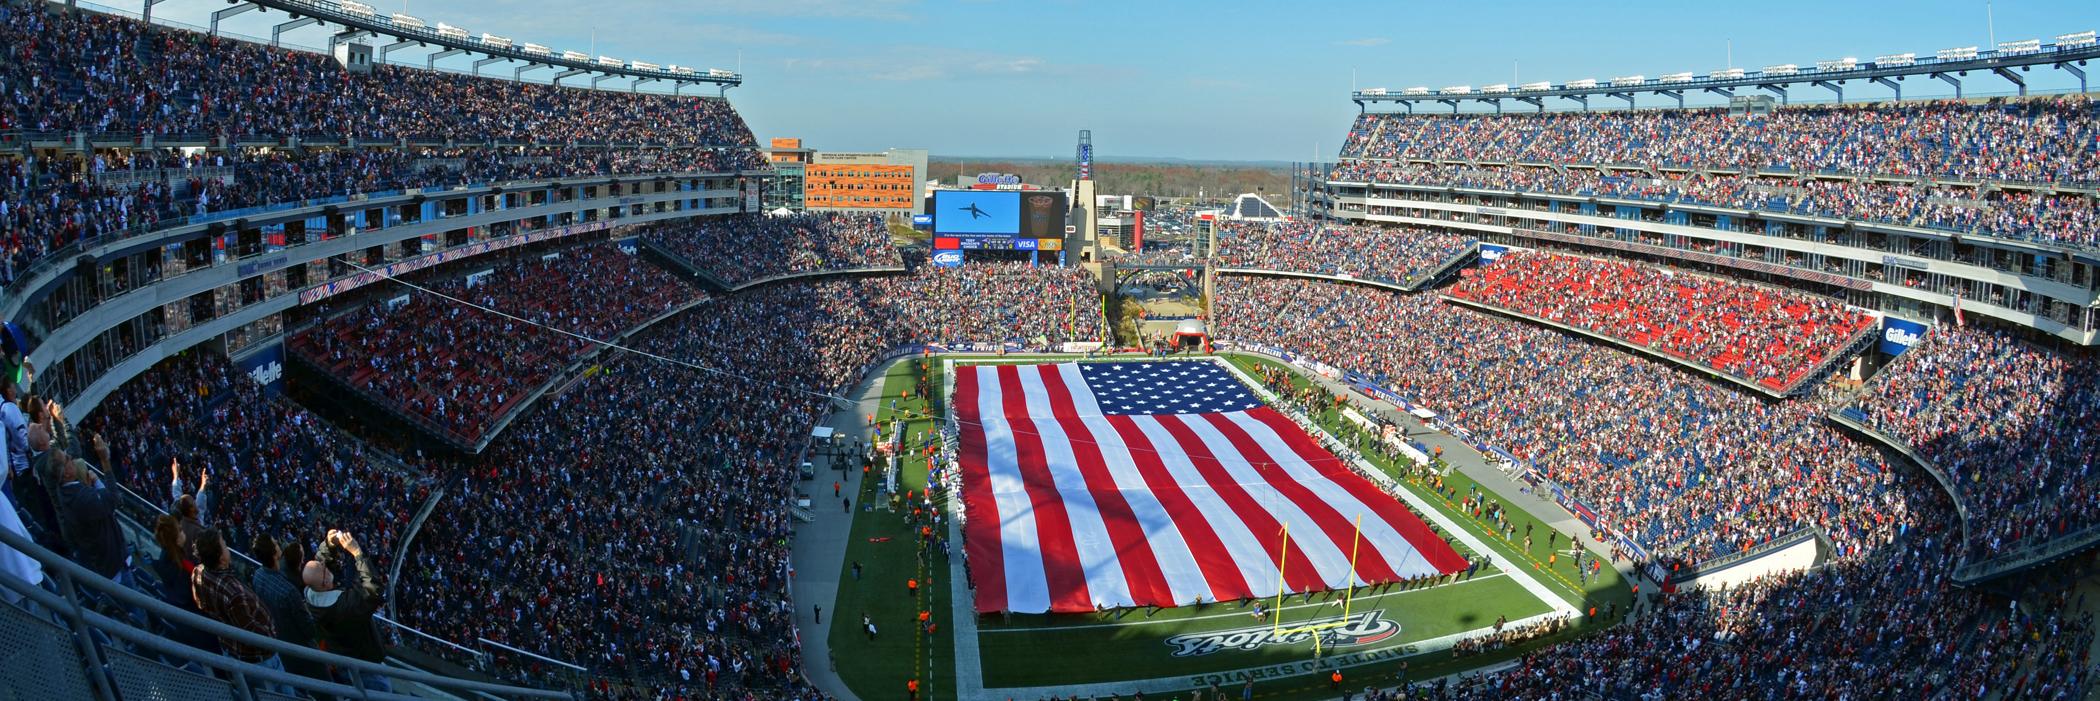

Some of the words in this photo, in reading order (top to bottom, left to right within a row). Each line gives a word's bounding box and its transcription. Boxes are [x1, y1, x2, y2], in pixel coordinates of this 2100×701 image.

[1302, 655, 1336, 673] TO
[1340, 644, 1419, 667] SALUTE
[1192, 664, 1298, 687] SERVICE
